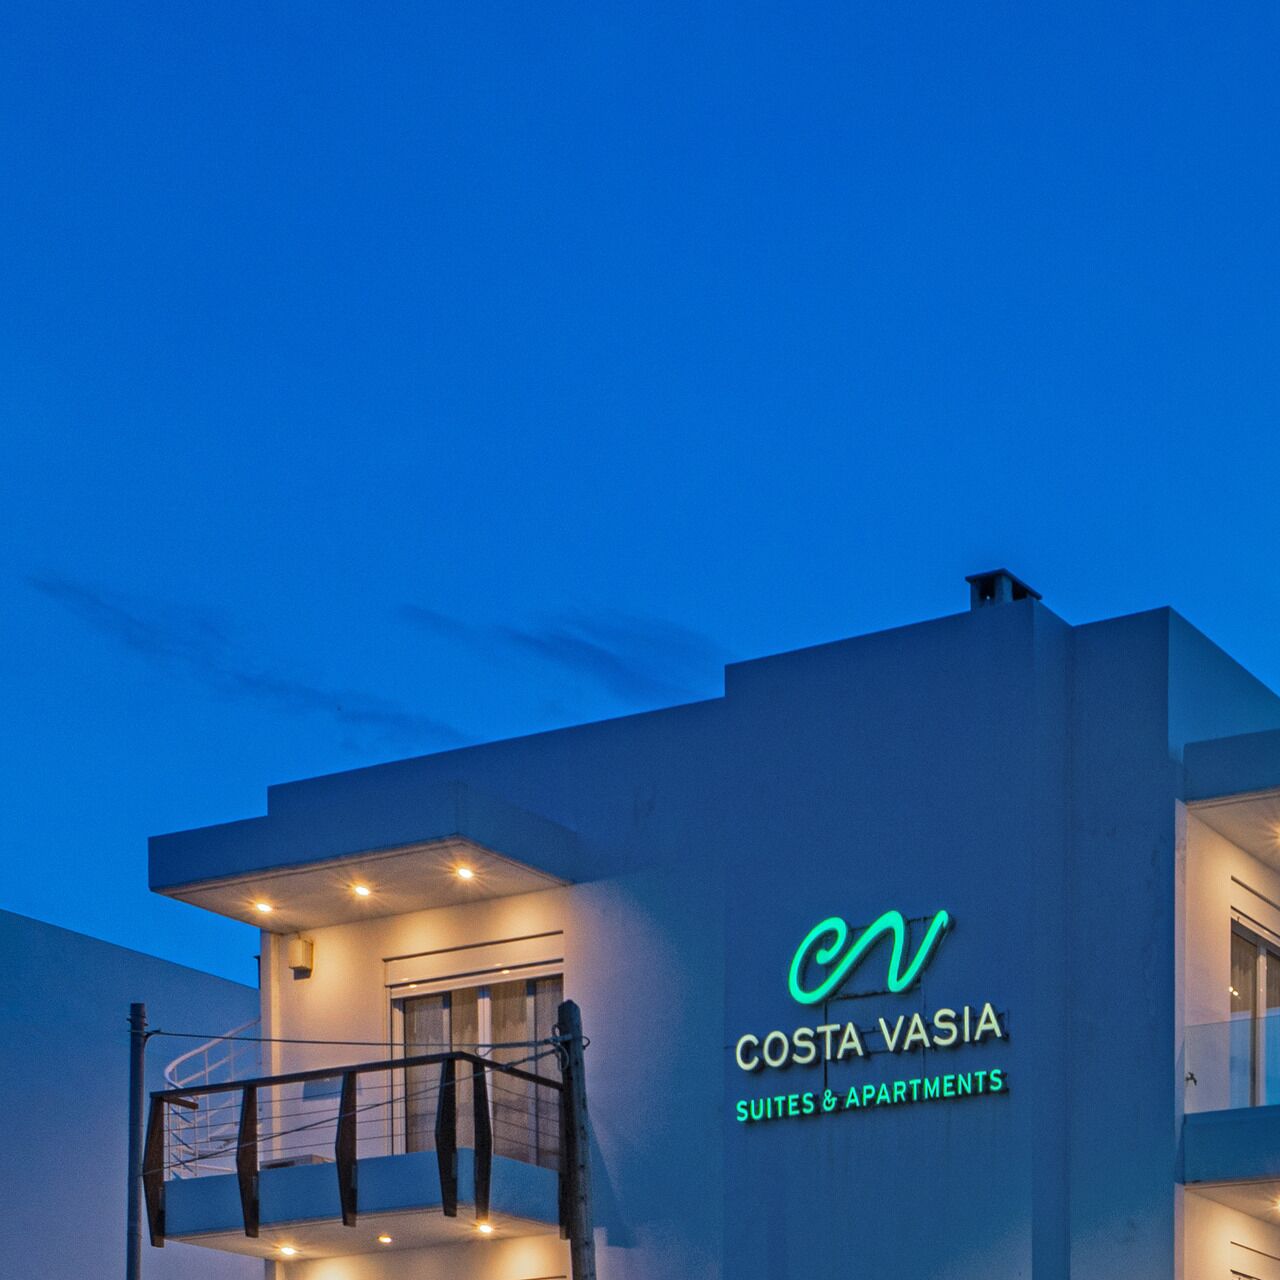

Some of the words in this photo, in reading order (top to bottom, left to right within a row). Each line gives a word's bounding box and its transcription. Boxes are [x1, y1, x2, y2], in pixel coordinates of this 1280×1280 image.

[735, 1021, 863, 1071] COSTA
[878, 1002, 1003, 1052] VASIA
[736, 1092, 815, 1122] SUITES
[822, 1089, 838, 1111] &
[845, 1068, 1004, 1109] APARTMENTS
